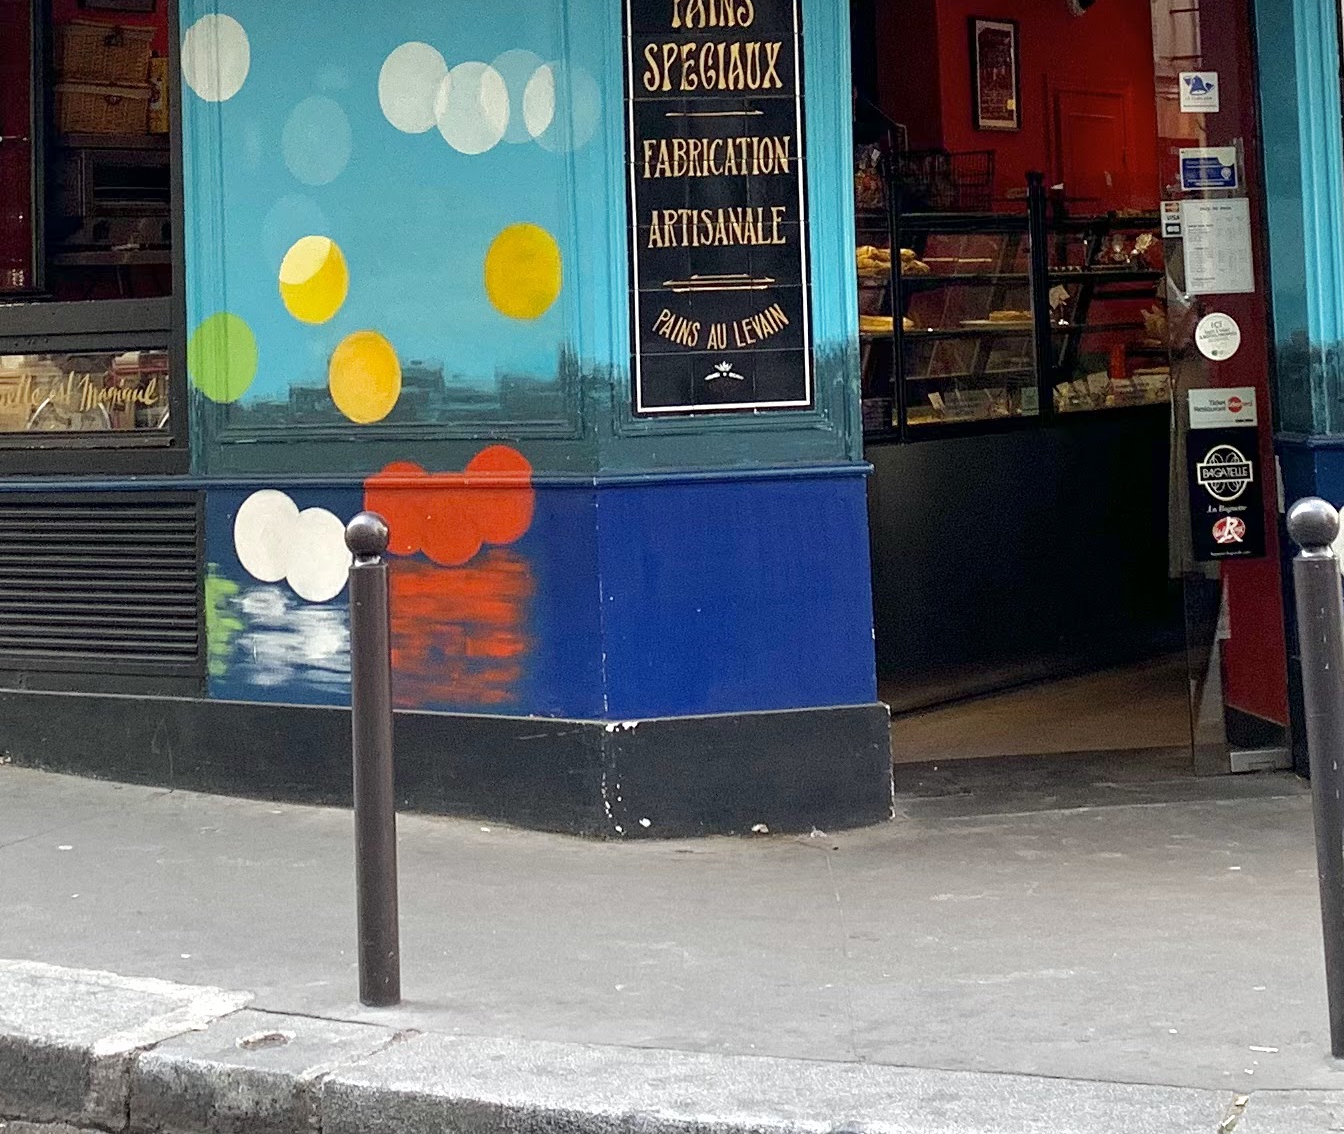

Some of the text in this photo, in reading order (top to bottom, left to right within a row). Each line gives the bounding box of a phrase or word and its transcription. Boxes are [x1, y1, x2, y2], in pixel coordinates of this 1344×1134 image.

[643, 41, 784, 92] SPECIAUX
[642, 136, 792, 179] FABRICATION
[647, 206, 787, 249] ARTISANALE
[651, 303, 789, 350] PAINS AU LEVAIN
[1203, 467, 1248, 479] BAGATELLE
